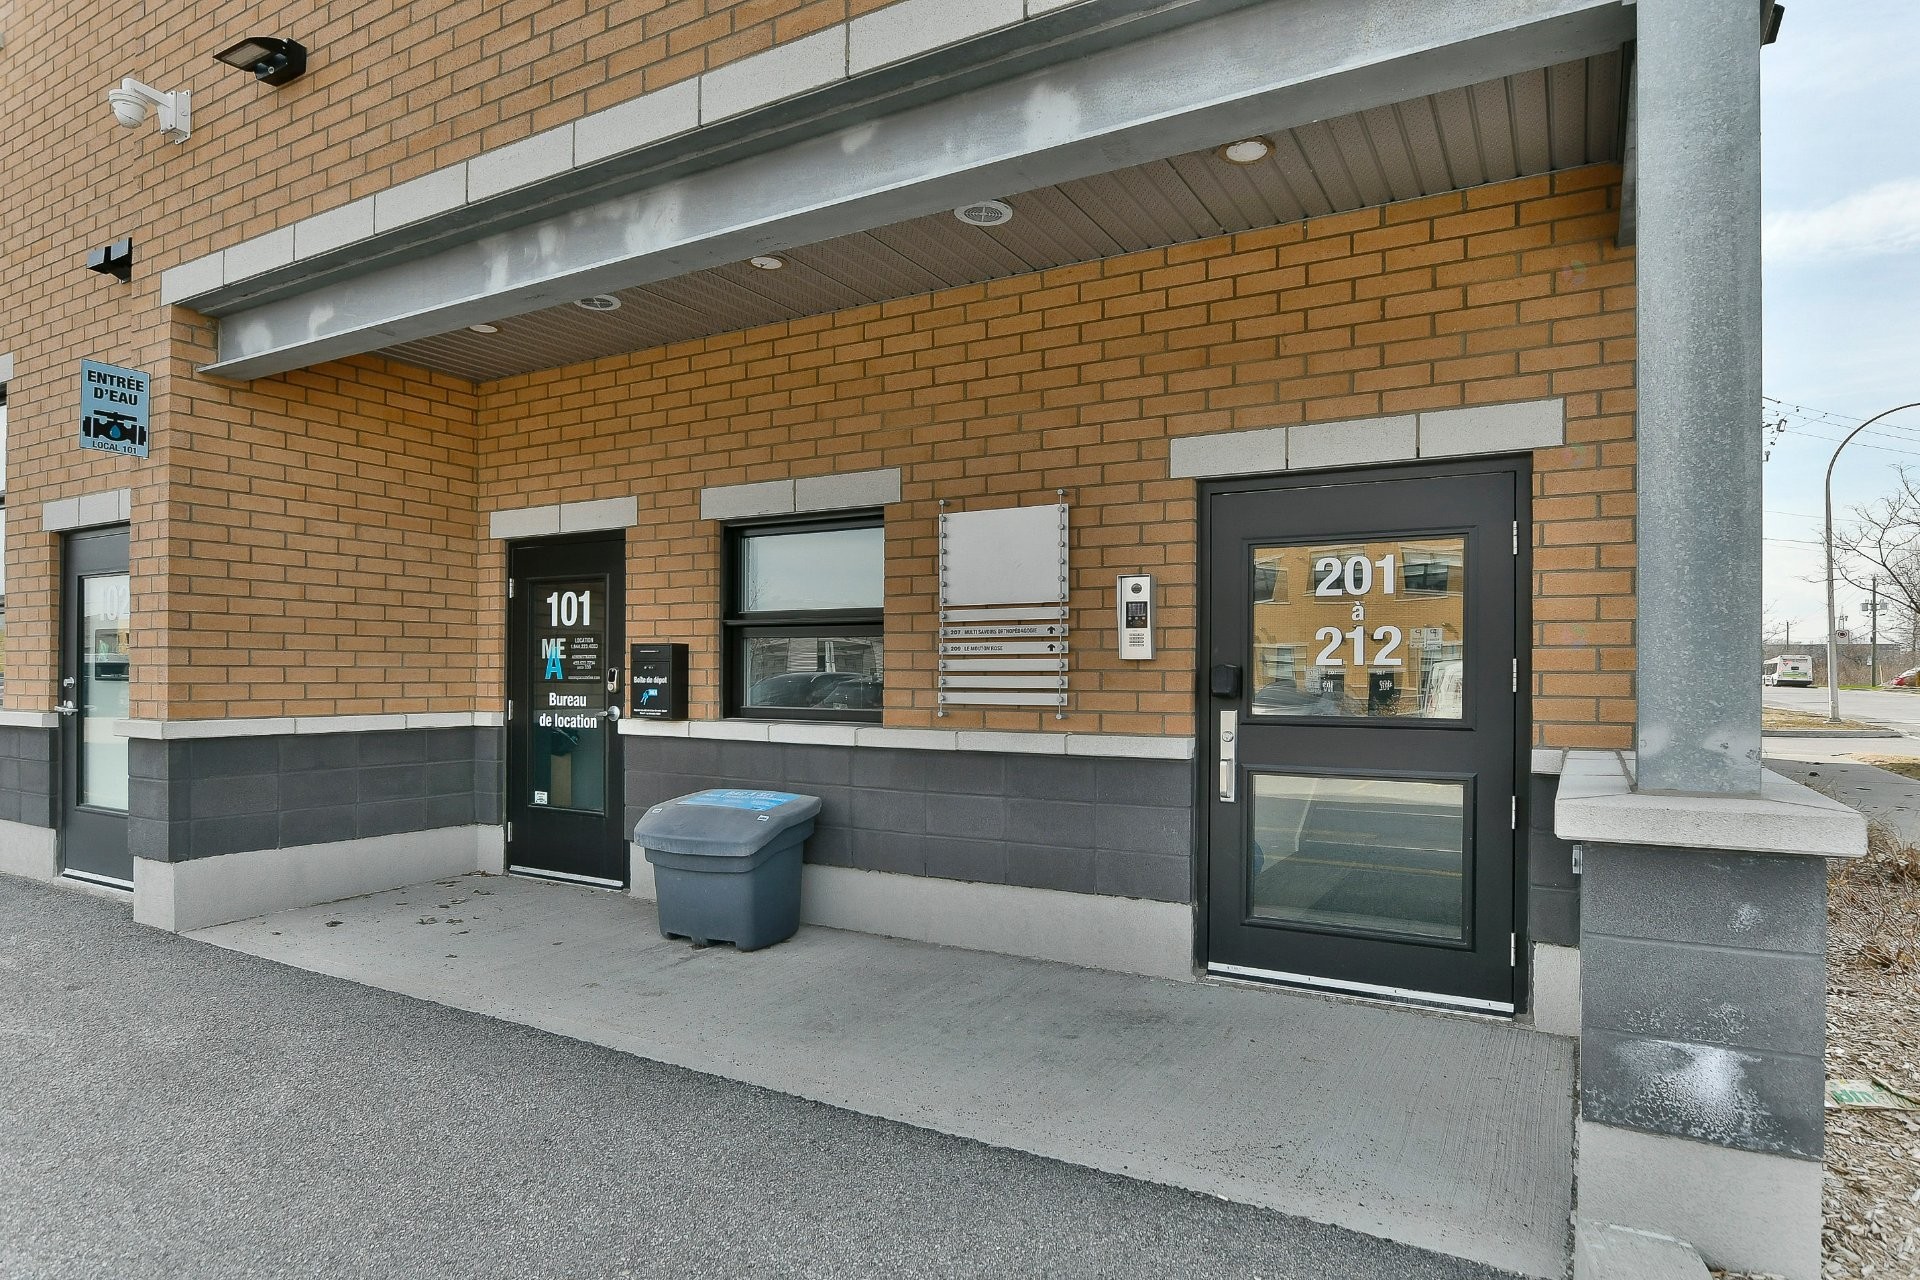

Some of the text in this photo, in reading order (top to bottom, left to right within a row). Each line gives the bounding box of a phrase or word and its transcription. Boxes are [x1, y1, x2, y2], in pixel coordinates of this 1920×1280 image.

[87, 369, 144, 392] ENTRÉE
[93, 387, 138, 406] D'EAU
[92, 440, 137, 454] LOCAL 101
[1315, 554, 1395, 597] 201
[546, 590, 590, 627] 101
[1351, 601, 1365, 621] à
[1315, 625, 1402, 666] 212
[647, 676, 653, 684] de
[548, 692, 587, 707] Bureau
[539, 712, 597, 729] de location
